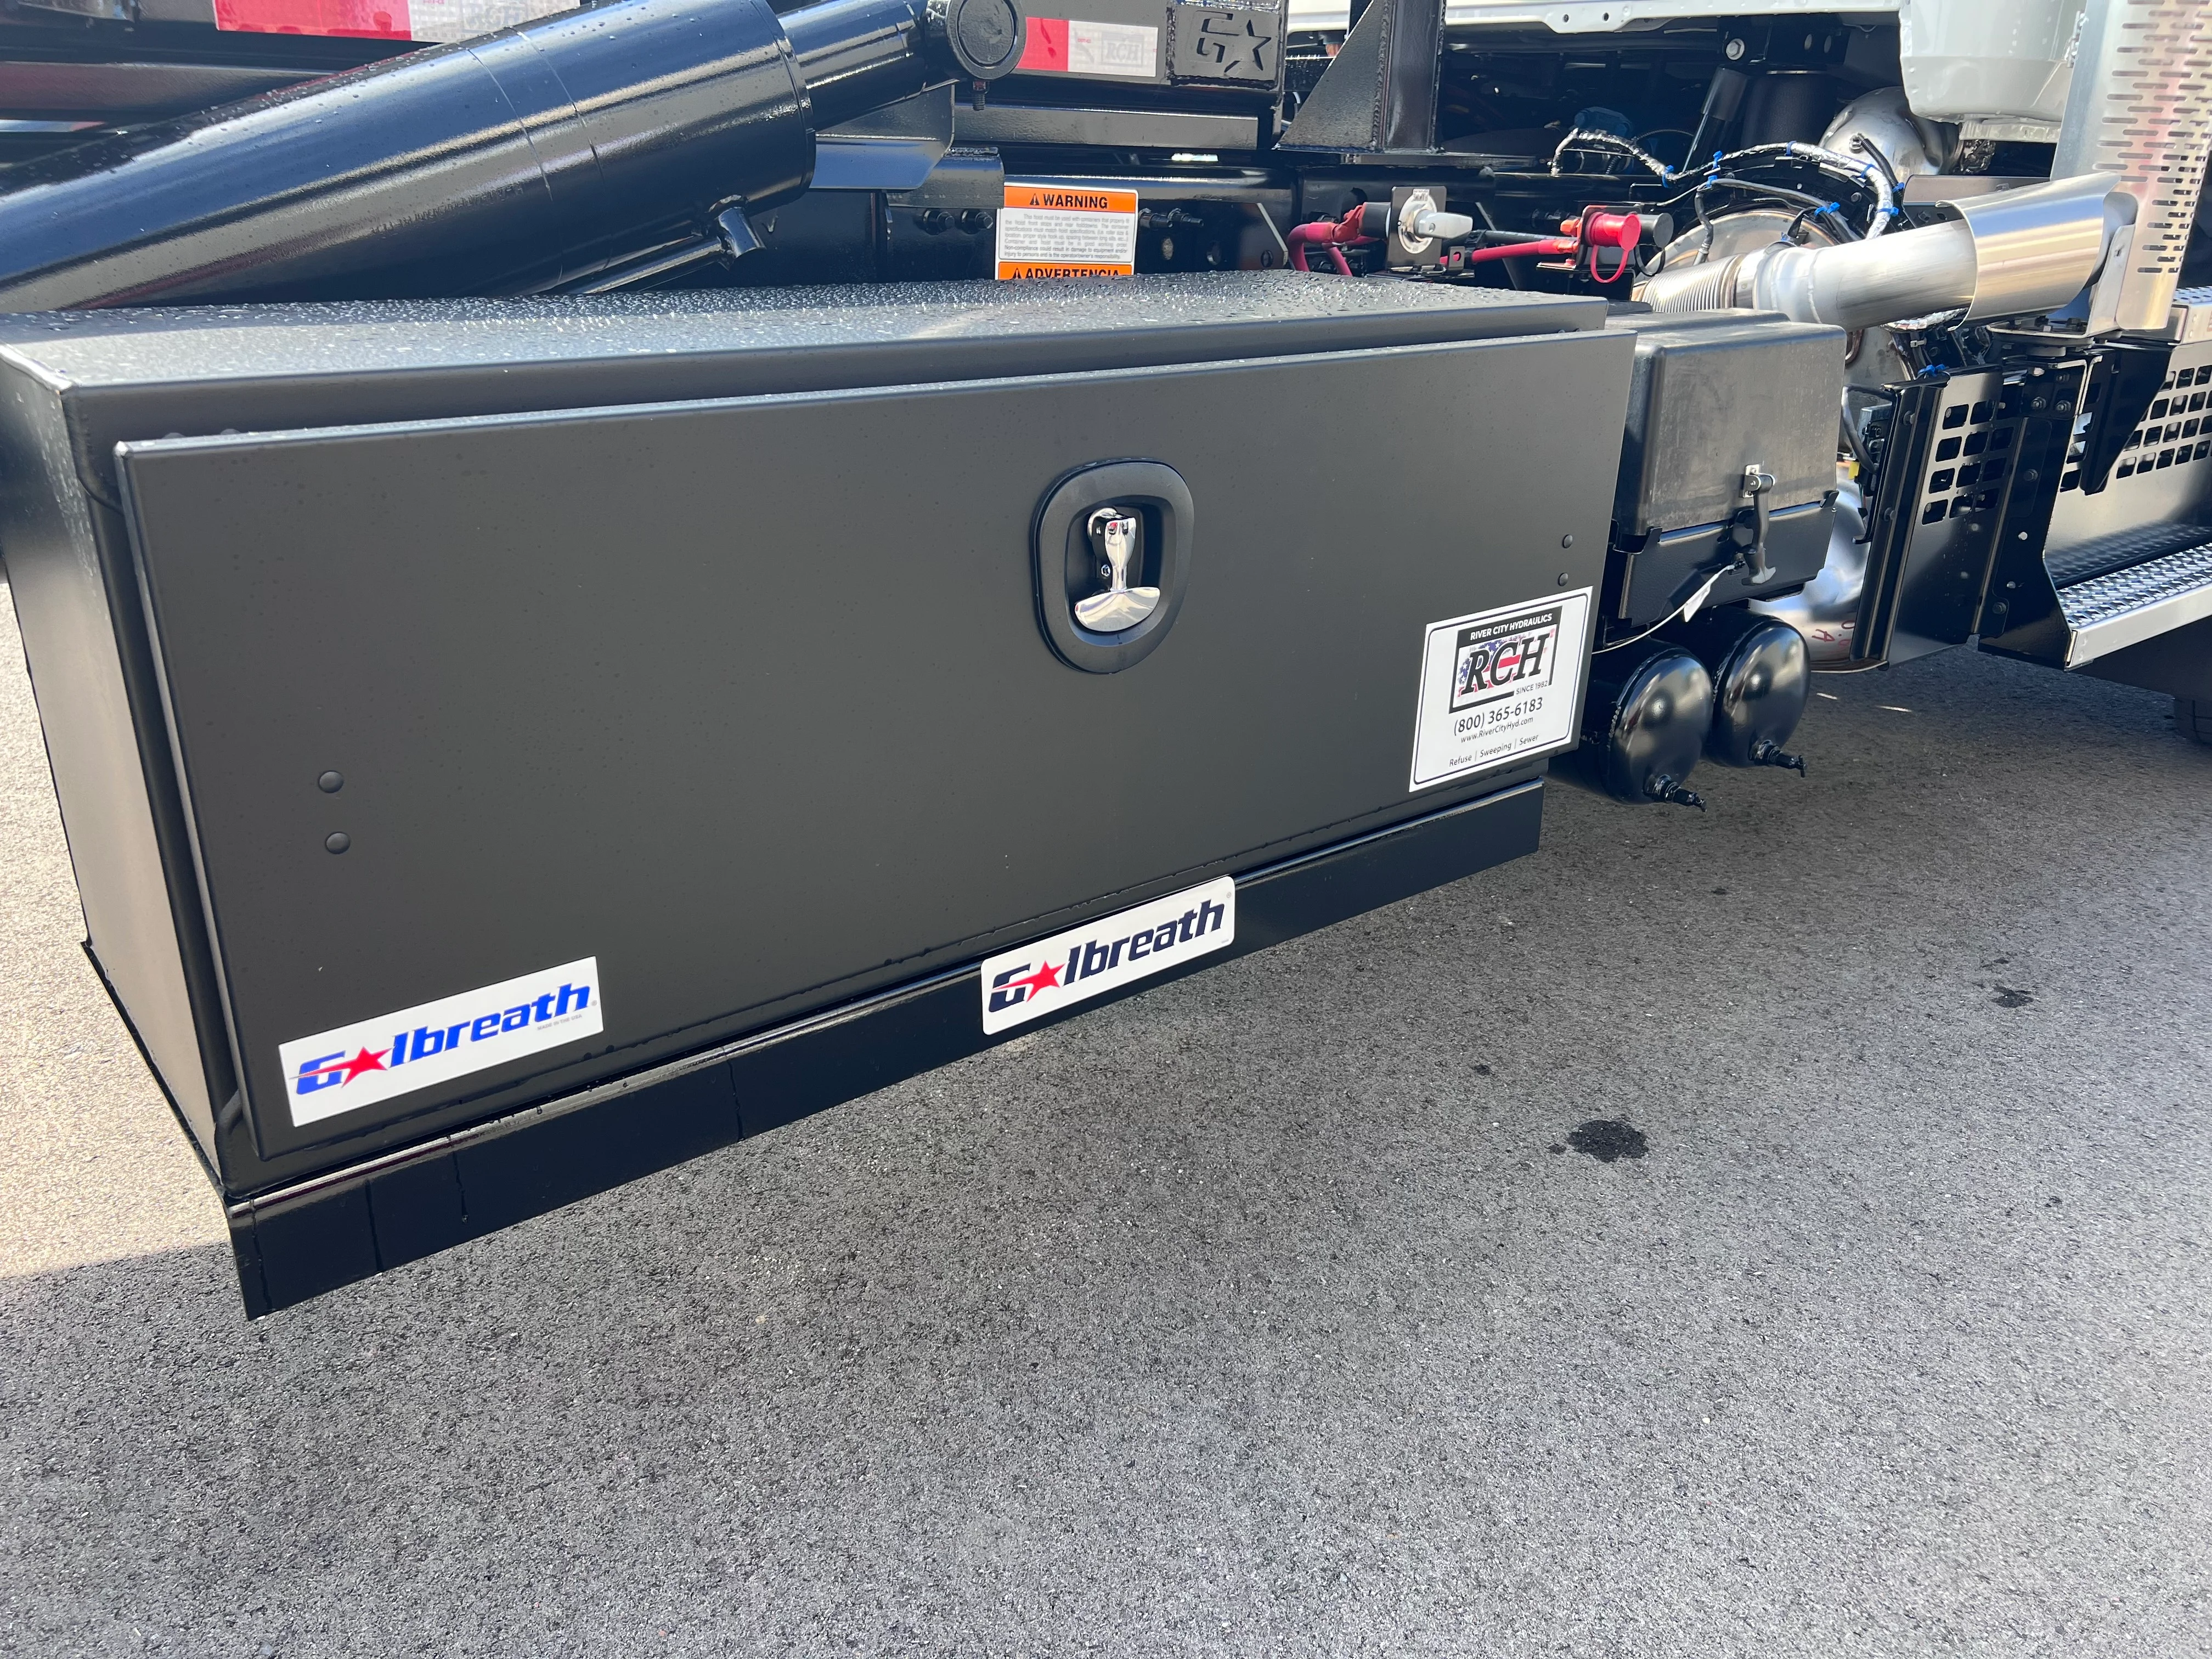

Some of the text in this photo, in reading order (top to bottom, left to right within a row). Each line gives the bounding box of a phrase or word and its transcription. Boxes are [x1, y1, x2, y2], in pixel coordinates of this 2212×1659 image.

[1105, 42, 1139, 61] RCH
[1043, 194, 1108, 208] WARNING
[1470, 613, 1553, 641] RIVER CITY HYDRAULICS
[1460, 632, 1550, 695] RCH
[1516, 680, 1548, 695] SINCE 1982
[1454, 697, 1543, 736] (800) 365-6183
[1461, 717, 1533, 743] www.RiverCityHyd.com
[1449, 735, 1539, 767] Refuse Sweeping Sewer
[537, 1022, 552, 1030] MADE
